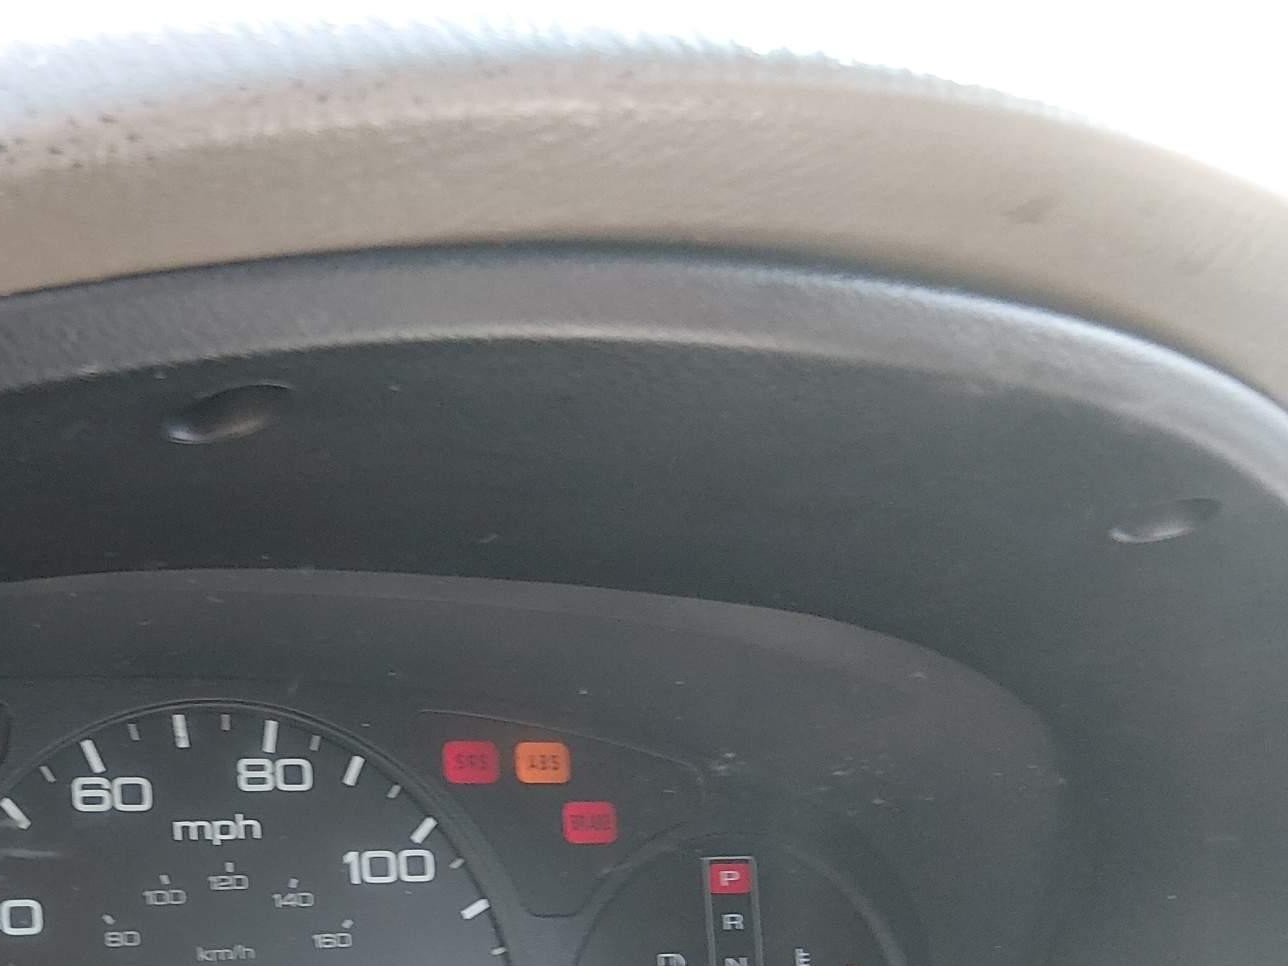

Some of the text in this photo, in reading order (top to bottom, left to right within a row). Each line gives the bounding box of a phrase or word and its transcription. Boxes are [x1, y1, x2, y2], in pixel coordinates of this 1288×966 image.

[237, 758, 313, 792] 80
[72, 776, 153, 812] 60
[172, 813, 262, 846] mph
[343, 849, 435, 885] 100
[208, 874, 249, 891] 120
[719, 870, 740, 886] P
[142, 889, 187, 905] 100
[272, 892, 314, 908] 140
[722, 913, 744, 930] R
[104, 930, 141, 947] 80
[312, 932, 353, 949] 160
[197, 945, 256, 961] km/h
